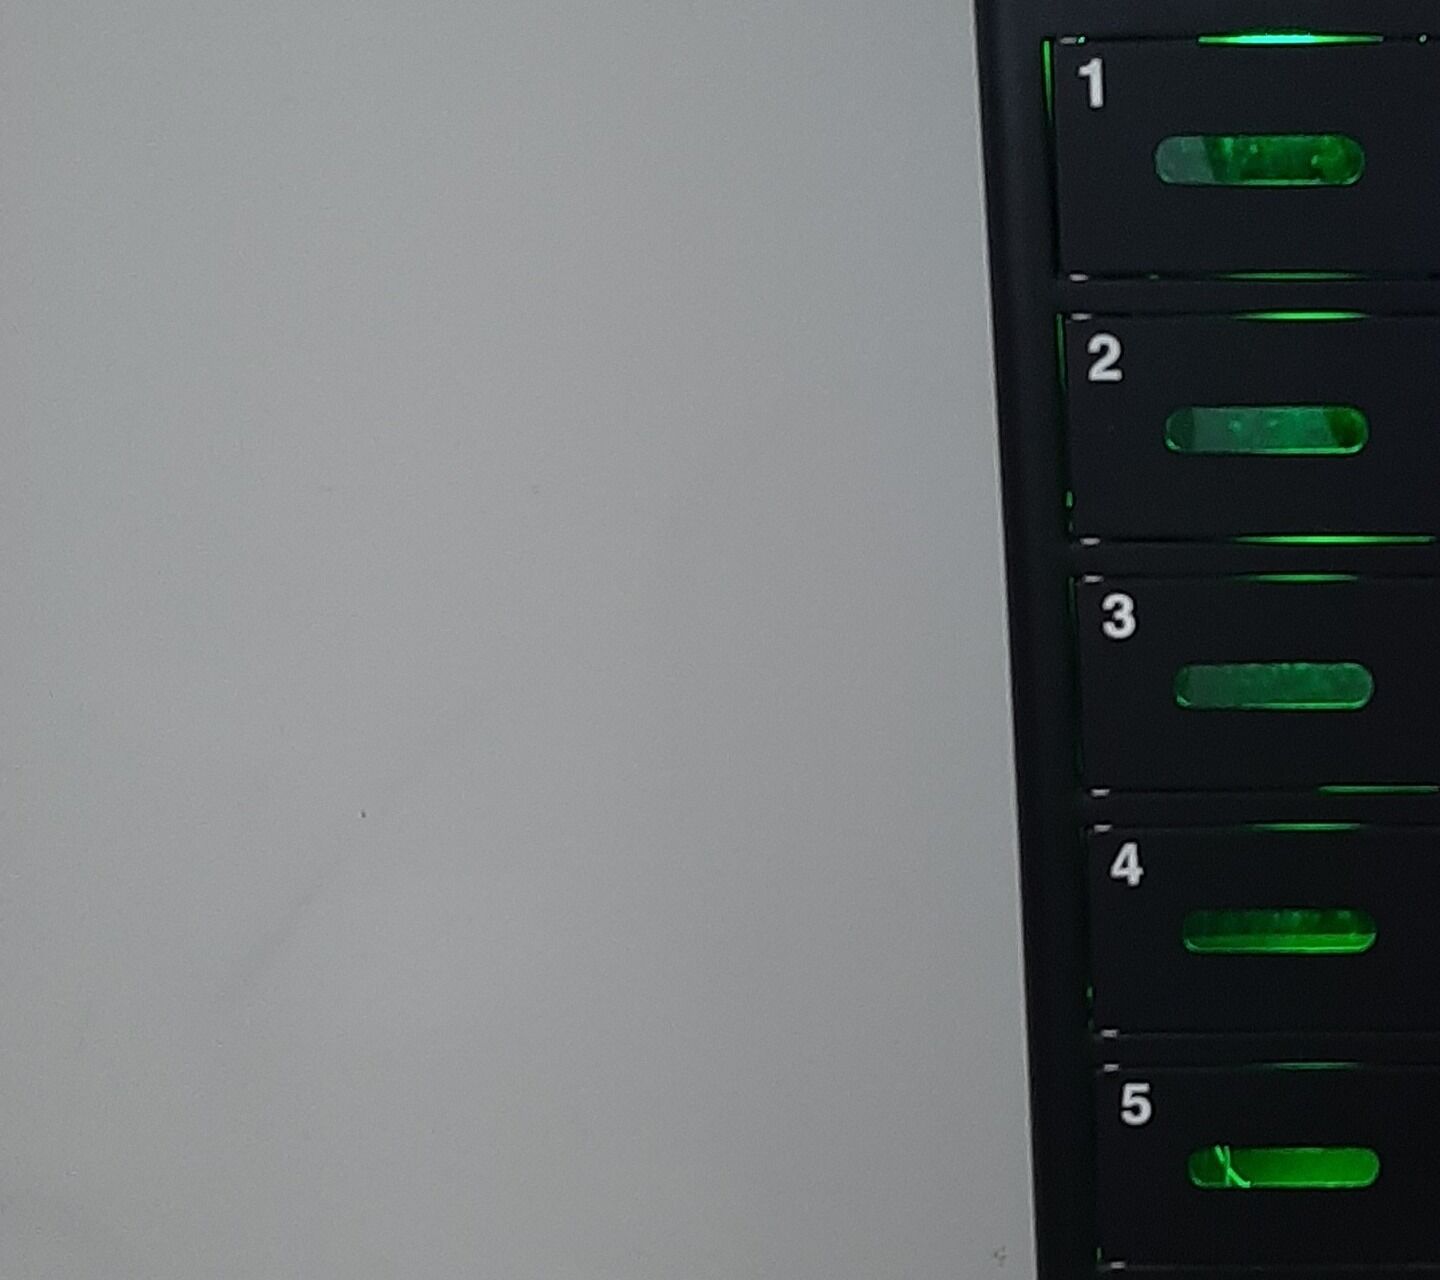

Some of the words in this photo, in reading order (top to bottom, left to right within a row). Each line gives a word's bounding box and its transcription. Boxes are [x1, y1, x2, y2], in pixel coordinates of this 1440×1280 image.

[1078, 57, 1103, 108] 1
[1087, 332, 1122, 382] 2
[1101, 592, 1137, 640] 3
[1110, 841, 1145, 886] 4
[1120, 1082, 1153, 1126] 5
